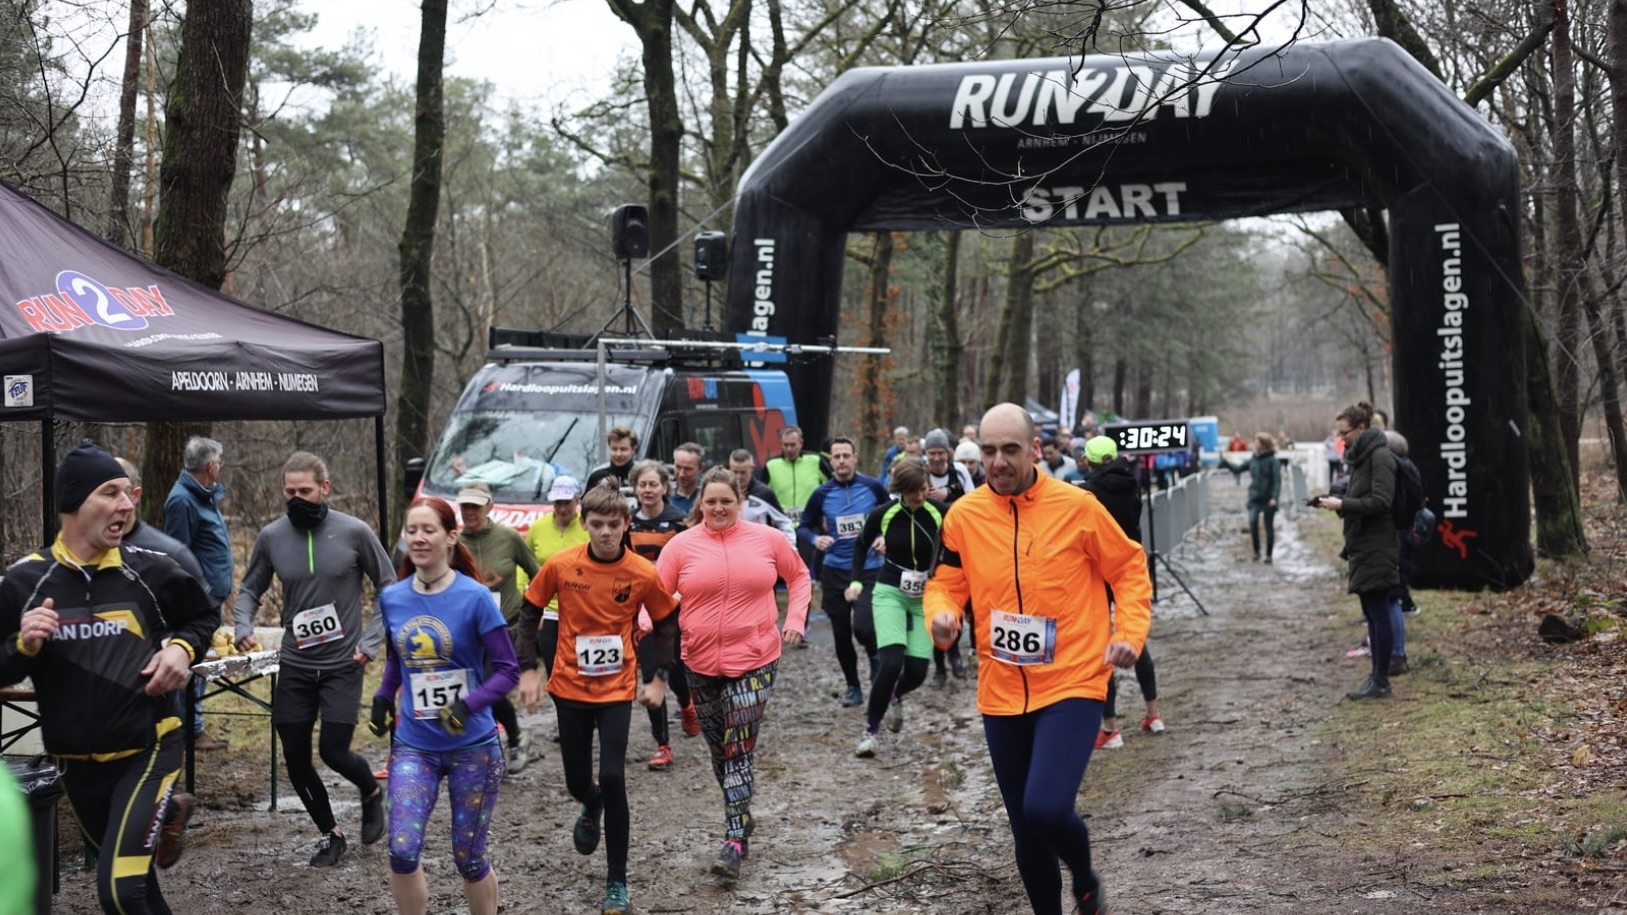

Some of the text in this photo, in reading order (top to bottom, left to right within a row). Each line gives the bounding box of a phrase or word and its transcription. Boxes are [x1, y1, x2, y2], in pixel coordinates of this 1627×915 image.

[949, 58, 1239, 129] RUN2DAY
[1016, 137, 1069, 149] ARNHEM
[1022, 181, 1188, 223] START
[746, 238, 776, 338] lagen.nl
[16, 277, 176, 333] RUN2DAY
[171, 370, 230, 391] APELDOORN
[235, 371, 274, 391] ARNHEM
[1434, 222, 1471, 519] Hardloopuitslagen.nl
[839, 520, 864, 533] 383
[47, 619, 129, 641] AN DORP
[297, 616, 336, 638] 360
[993, 626, 1041, 653] 286
[580, 648, 620, 665] 123
[417, 683, 463, 707] 157
